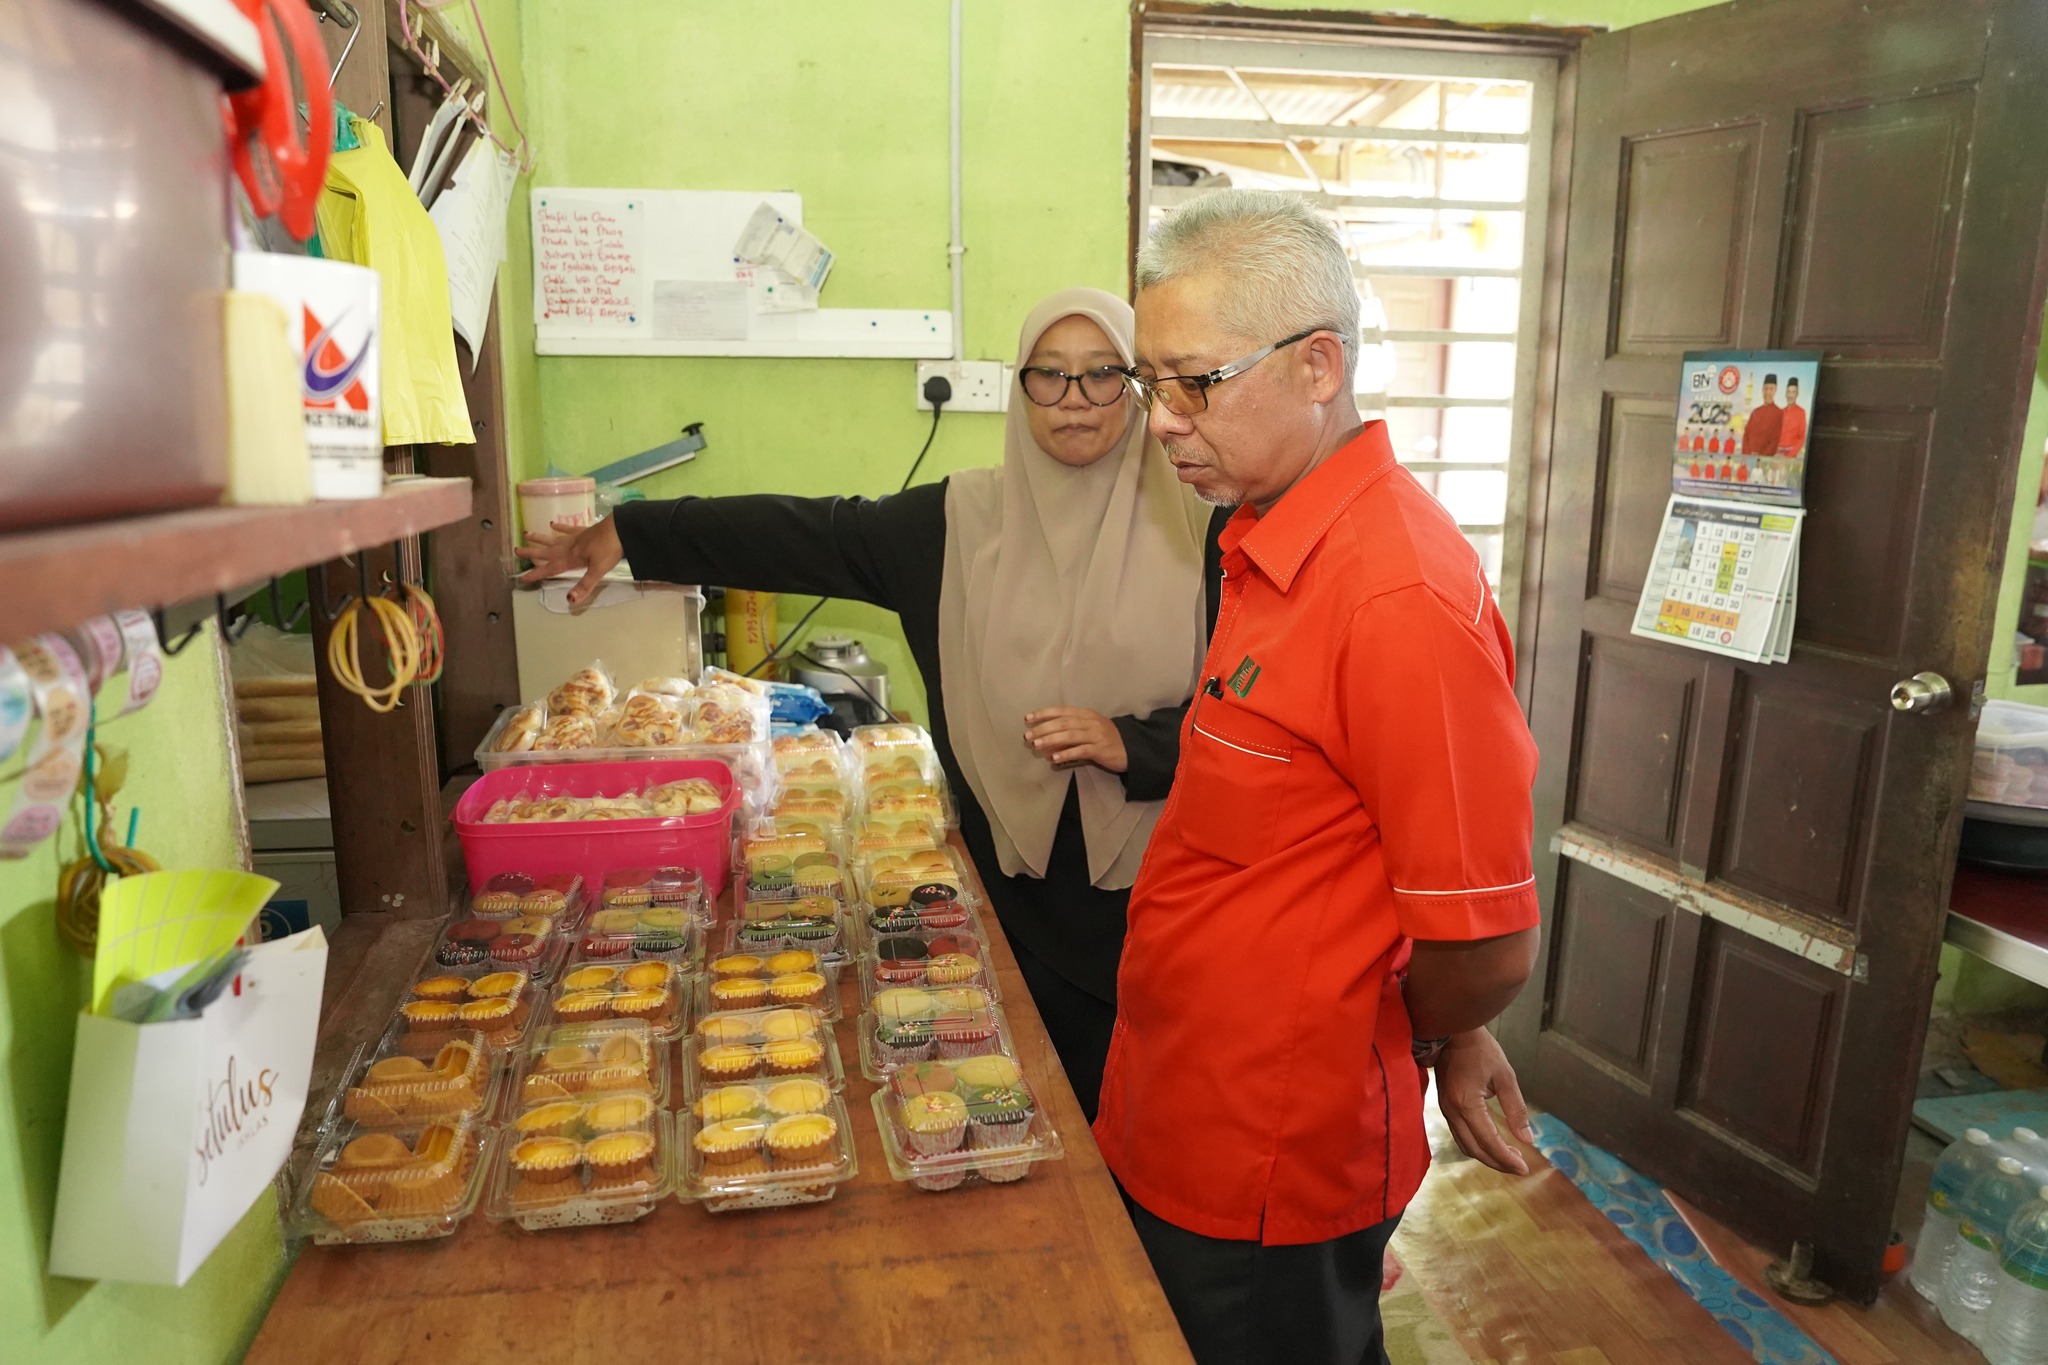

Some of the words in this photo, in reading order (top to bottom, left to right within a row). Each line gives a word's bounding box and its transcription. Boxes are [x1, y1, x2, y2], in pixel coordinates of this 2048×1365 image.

[1693, 373, 1710, 388] BN
[1689, 402, 1732, 425] 2025
[1715, 528, 1724, 537] 12
[1744, 532, 1755, 541] 26
[1711, 544, 1720, 553] 13
[1740, 550, 1752, 558] 27
[1708, 561, 1717, 570] 14
[1722, 564, 1732, 573] 21
[1737, 566, 1748, 576] 28
[1704, 578, 1713, 587] 15
[1718, 580, 1728, 589] 22
[1733, 583, 1744, 592] 29
[1700, 594, 1709, 603] 16
[1714, 597, 1724, 606] 23
[1728, 599, 1740, 608] 30
[1681, 608, 1690, 616] 10
[1696, 610, 1705, 619] 17
[1710, 613, 1720, 622] 24
[1724, 616, 1734, 625] 31
[1706, 629, 1716, 639] 25
